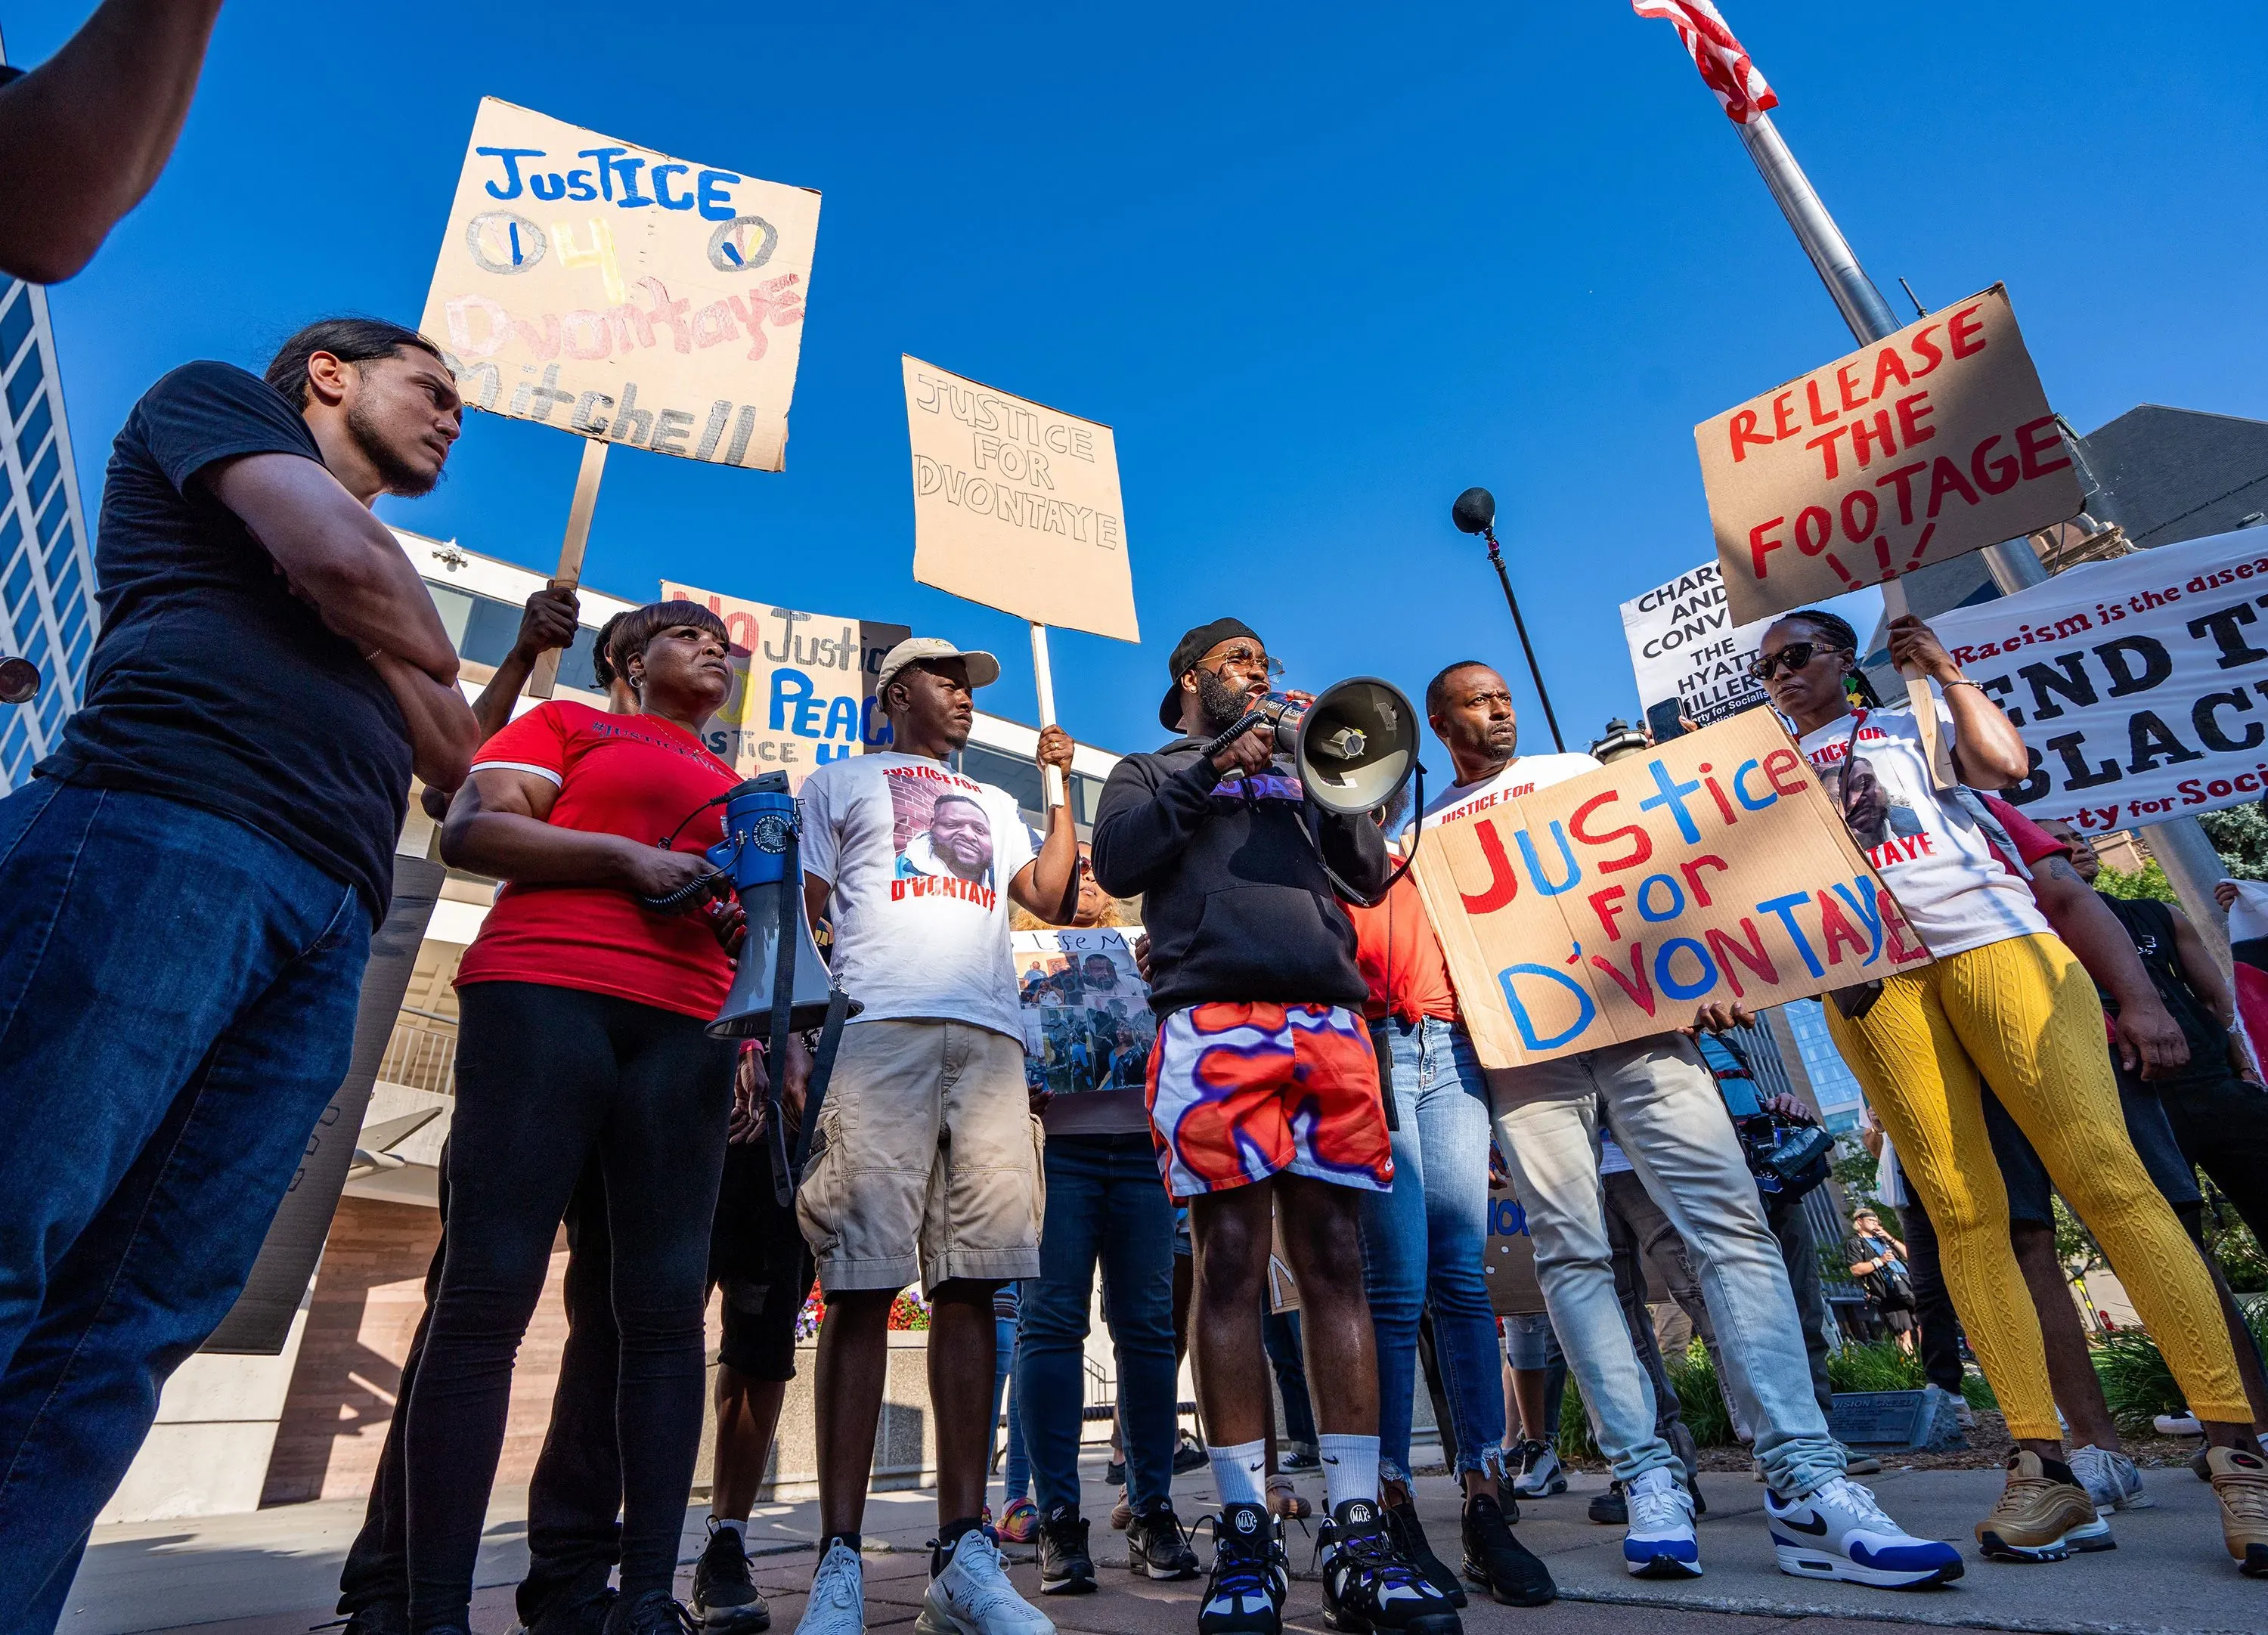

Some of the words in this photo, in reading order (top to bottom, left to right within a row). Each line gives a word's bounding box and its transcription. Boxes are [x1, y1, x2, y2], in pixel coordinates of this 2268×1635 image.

[550, 217, 625, 302] 4
[1730, 302, 1988, 463] RELEASE
[916, 373, 1095, 463] JUSTICE
[1805, 391, 1936, 480] THE
[973, 432, 1055, 491] FOR
[913, 454, 1117, 550] DVONTAYE
[1749, 416, 2072, 580] FOOTAGE
[1638, 562, 1723, 613] CHAR
[1671, 584, 1727, 626] AND
[1950, 611, 2093, 667] Racism
[2097, 602, 2127, 625] is
[2127, 584, 2182, 614] the
[2186, 558, 2268, 593] disea
[764, 607, 897, 675] Justic
[1642, 608, 1727, 659] CONV
[1690, 637, 1737, 667] THE
[1678, 649, 1760, 695] HYATT
[769, 667, 894, 747] PEAC
[1266, 700, 1283, 711] FIGHT
[1712, 704, 1727, 716] for
[1728, 690, 1770, 710] Socialis
[1858, 726, 1888, 741] OR
[1999, 679, 2268, 807] BLAC
[953, 776, 983, 794] FOR
[1504, 782, 1535, 802] FOR
[2127, 796, 2177, 818] for
[2177, 763, 2268, 806] Soci
[1238, 1516, 1254, 1528] MAX
[1352, 1511, 1368, 1522] MAX
